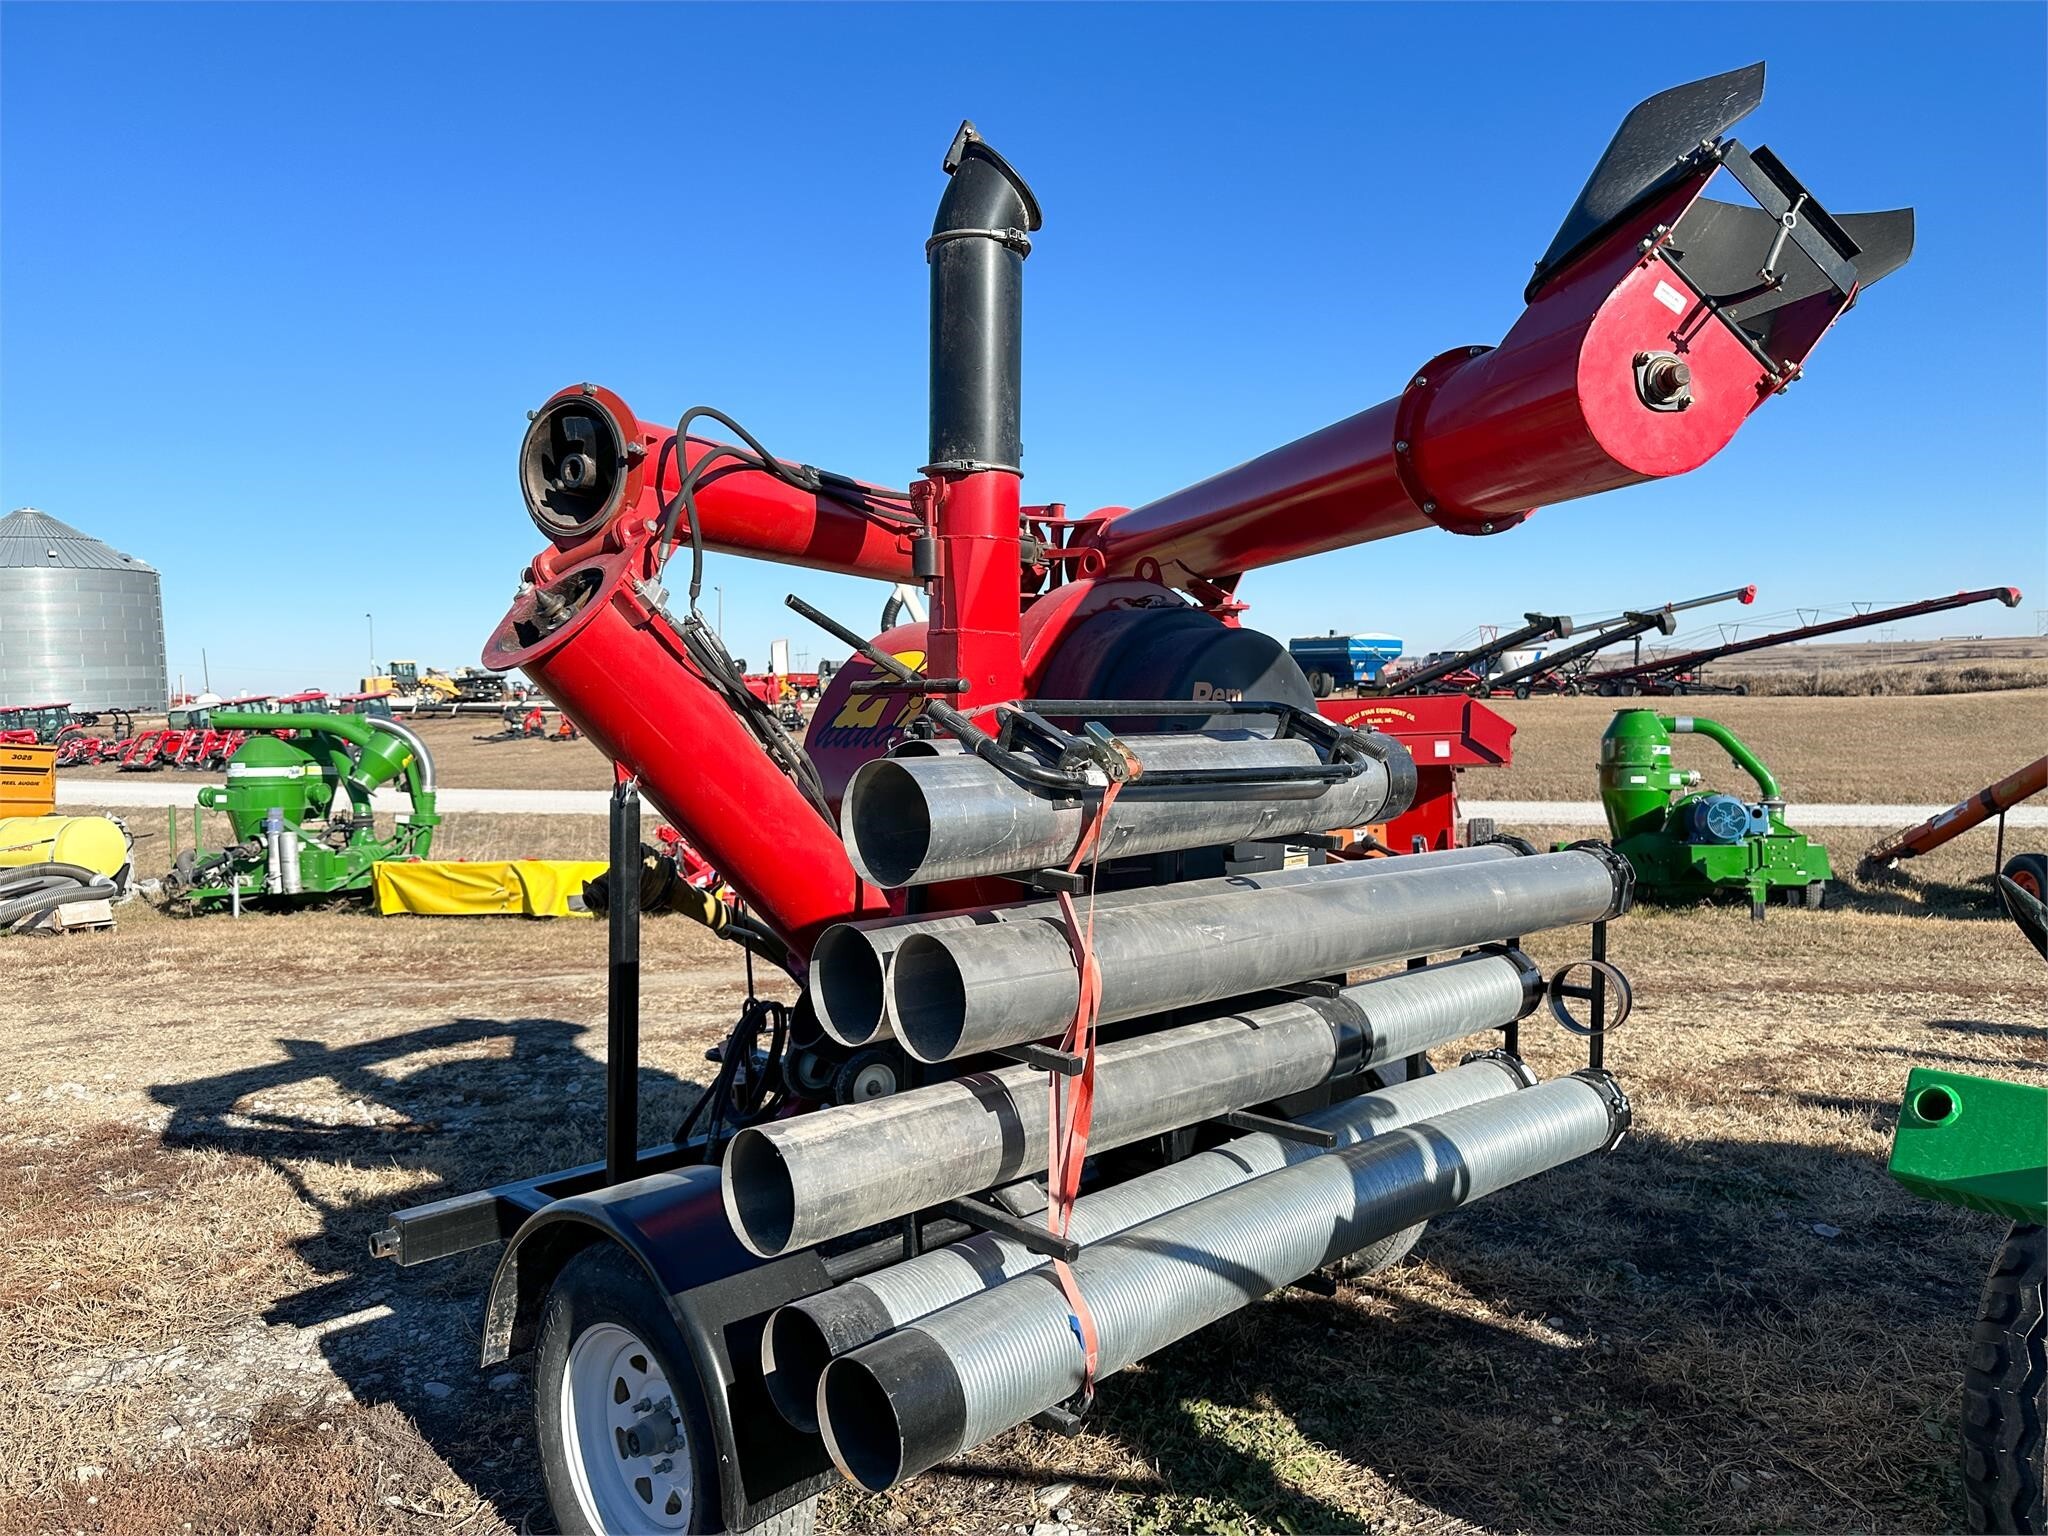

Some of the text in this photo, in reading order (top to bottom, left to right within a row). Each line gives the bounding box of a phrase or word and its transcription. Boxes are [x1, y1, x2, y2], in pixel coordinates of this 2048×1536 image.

[1193, 681, 1242, 702] Rem
[1344, 712, 1361, 725] KELLY
[1360, 708, 1375, 717] RYAN
[1375, 707, 1407, 718] EQUIPMENT
